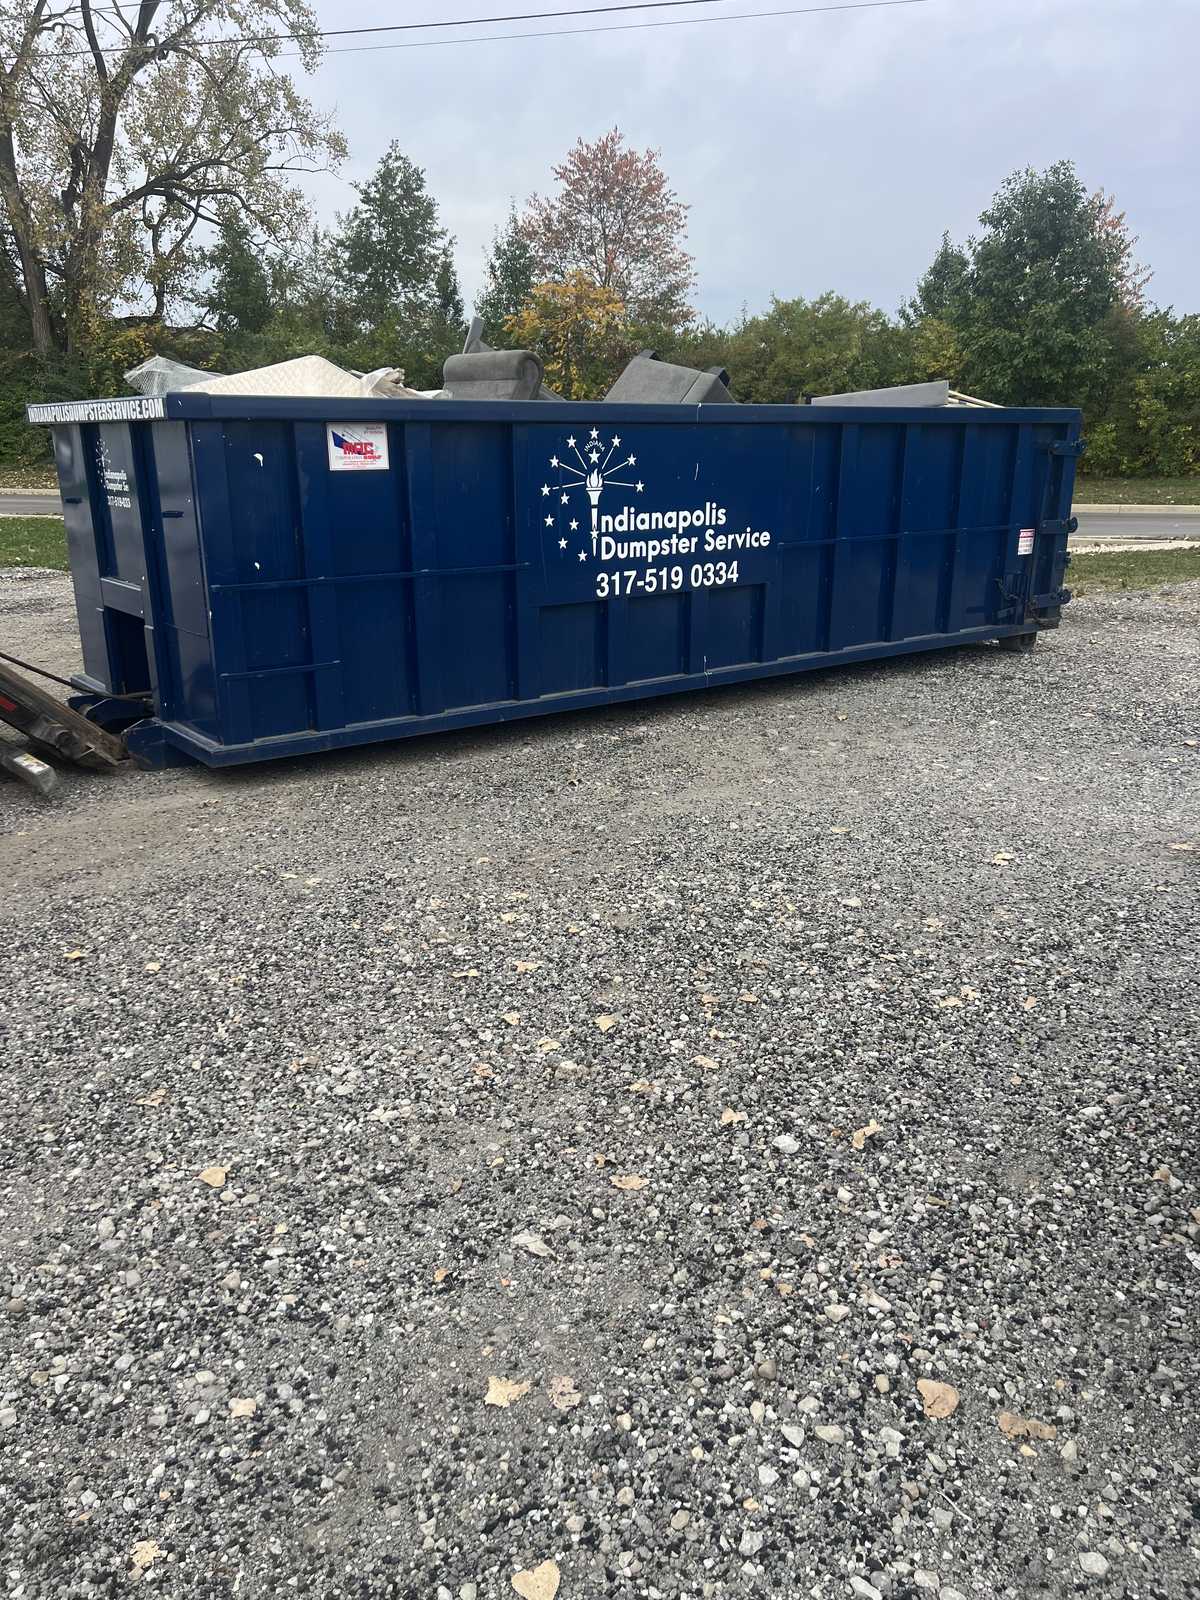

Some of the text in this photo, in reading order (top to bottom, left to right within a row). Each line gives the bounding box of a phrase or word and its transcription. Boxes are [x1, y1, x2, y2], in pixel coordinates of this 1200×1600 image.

[601, 527, 771, 562] Dumpster Service
[596, 560, 739, 598] 317-519 0334
